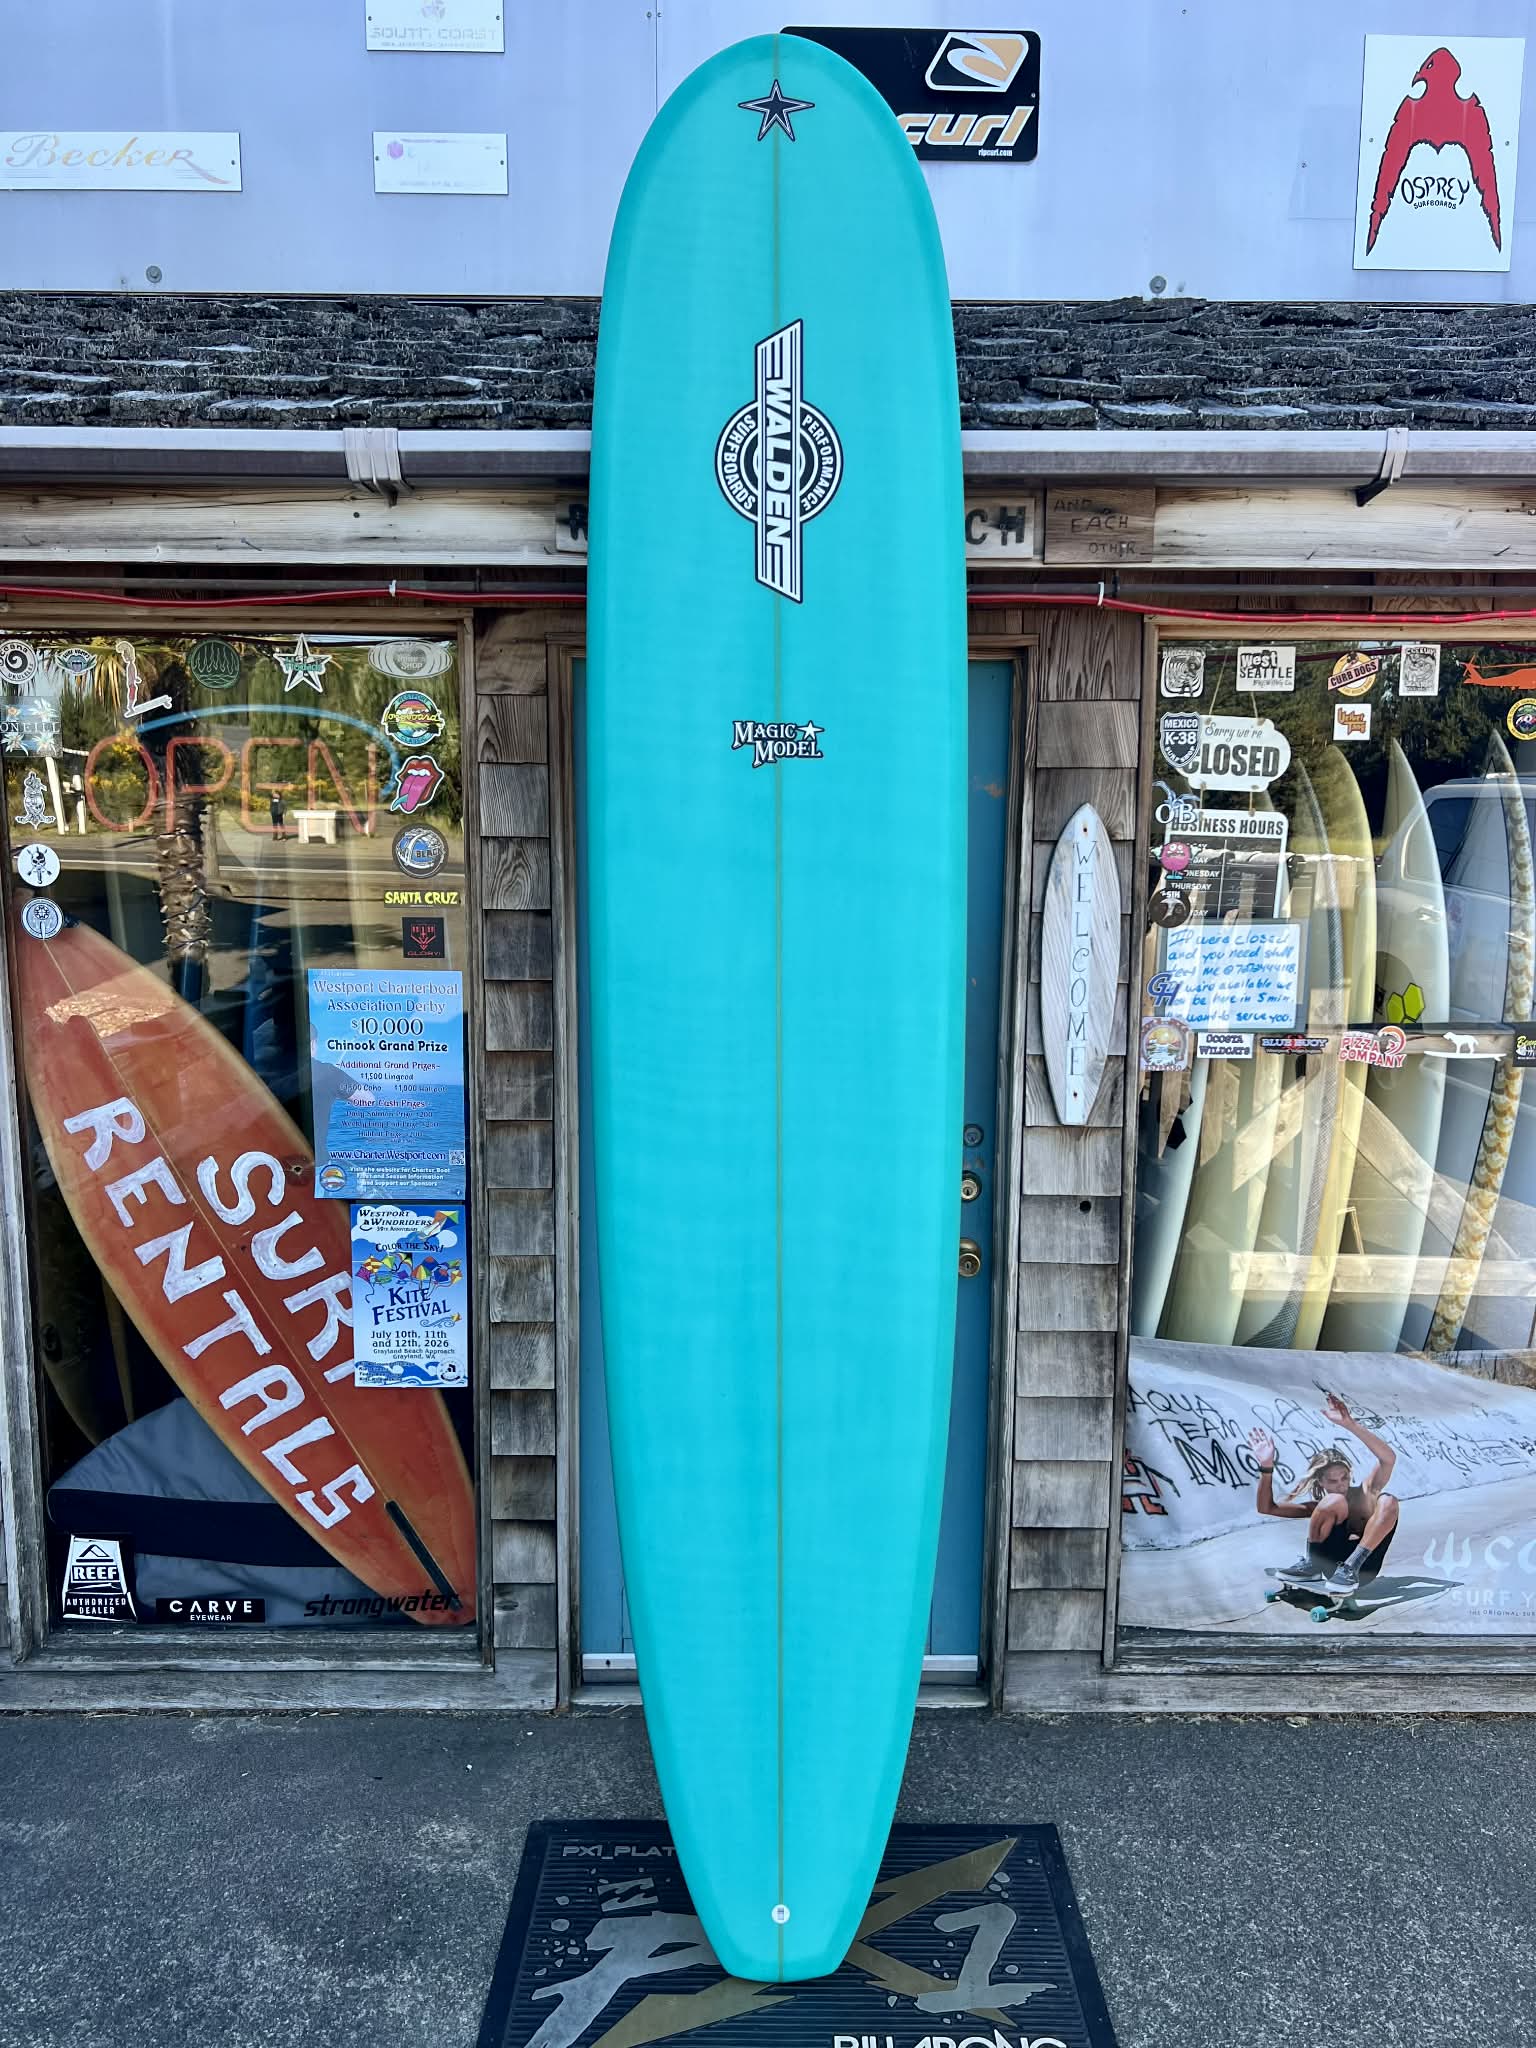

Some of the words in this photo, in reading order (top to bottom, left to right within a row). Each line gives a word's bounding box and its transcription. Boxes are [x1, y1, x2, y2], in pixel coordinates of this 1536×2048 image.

[978, 149, 1013, 157] ripcurl.com
[1401, 176, 1470, 205] OSPREY
[1413, 200, 1457, 210] SURFBOARDS
[723, 414, 756, 511] SURFBOARDS
[766, 378, 791, 546] WALDEN
[801, 414, 833, 512] PERFORMANCE
[1071, 515, 1128, 533] EACH
[1239, 667, 1293, 679] SEATTLE
[1330, 671, 1354, 687] CURB
[1354, 661, 1377, 678] DOGS
[1164, 719, 1198, 729] MEXICO
[1205, 721, 1235, 742] Sorry
[1236, 726, 1263, 739] we're
[731, 720, 797, 750] MAGIC
[1165, 731, 1197, 745] K-38
[752, 740, 823, 768] MODEL
[85, 735, 377, 834] OPEN
[1240, 820, 1284, 835] HOURS
[1171, 882, 1212, 890] THURSDAY
[384, 891, 422, 905] SANTA
[424, 891, 459, 905] CRUZ
[1066, 840, 1097, 1076] WELCOME
[1168, 948, 1197, 960] and
[1202, 951, 1224, 964] you
[314, 980, 374, 995] Westport
[378, 980, 459, 995] Charterboat
[1192, 996, 1206, 1005] be
[1257, 992, 1267, 1003] 5
[327, 999, 402, 1011] Association
[406, 999, 446, 1014] Derby
[351, 1017, 424, 1035] $10,000
[327, 1039, 375, 1050] Chinook
[379, 1040, 414, 1051] Grand
[418, 1041, 448, 1052] Prize
[1340, 1037, 1380, 1052] PIZZA
[384, 1061, 409, 1069] Grand
[1339, 1050, 1406, 1068] COMPANY
[330, 1150, 446, 1161] www.CharterWestport.com
[359, 1209, 410, 1217] WESTPORT
[371, 1217, 433, 1226] WINDRIDERS
[375, 1243, 402, 1252] COLOR
[405, 1242, 420, 1250] THE
[423, 1242, 444, 1253] SKY!
[197, 1150, 356, 1384] SUR
[388, 1286, 431, 1306] KITE
[64, 1097, 376, 1529] RENTALS
[372, 1299, 451, 1326] FESTIVAL
[370, 1330, 392, 1339] July
[395, 1330, 421, 1339] 10th,
[425, 1330, 447, 1339] 11th
[372, 1339, 391, 1347] and
[395, 1339, 421, 1348] 12th,
[424, 1339, 449, 1347] 2026
[1148, 1418, 1250, 1444] TEAM
[73, 1567, 118, 1580] REEF
[66, 1597, 126, 1606] AUTHORIZED
[304, 1589, 460, 1618] strongwater
[1451, 1588, 1512, 1606] SURF
[79, 1606, 115, 1614] DEALER
[169, 1600, 252, 1613] CARVE
